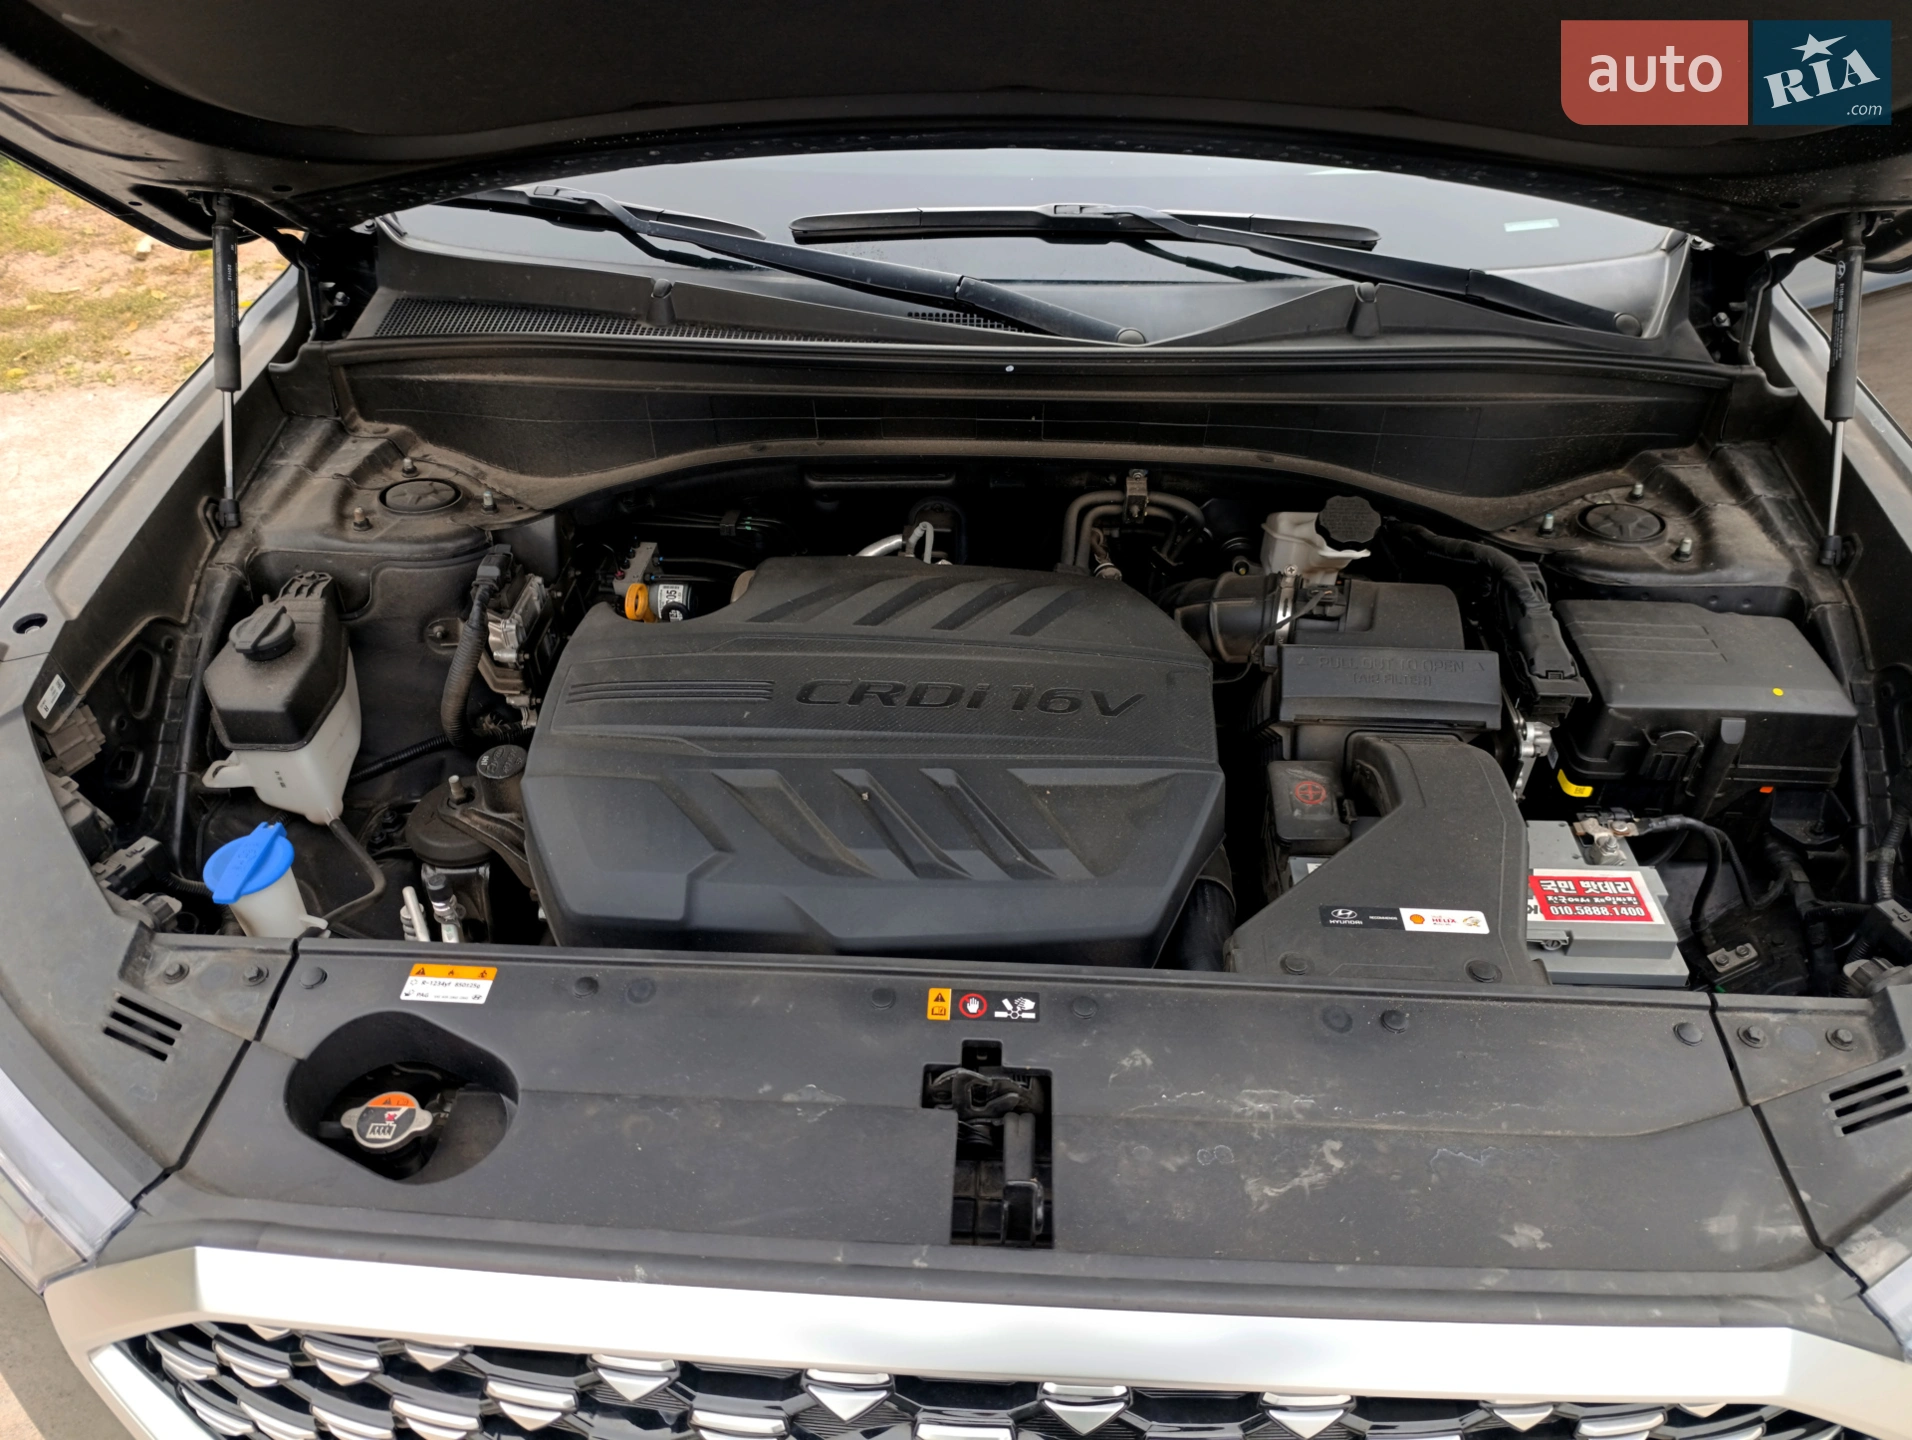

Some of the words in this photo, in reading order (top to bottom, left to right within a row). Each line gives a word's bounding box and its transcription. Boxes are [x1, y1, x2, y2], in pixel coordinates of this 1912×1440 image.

[1319, 656, 1358, 670] PULL
[1363, 657, 1393, 670] OUT
[1398, 658, 1417, 671] TO
[1423, 659, 1465, 673] OPEN
[795, 679, 990, 710] CRDi
[1012, 684, 1148, 718] 16V
[1540, 880, 1577, 894] 국민
[1549, 906, 1645, 916] 010.5888.1400
